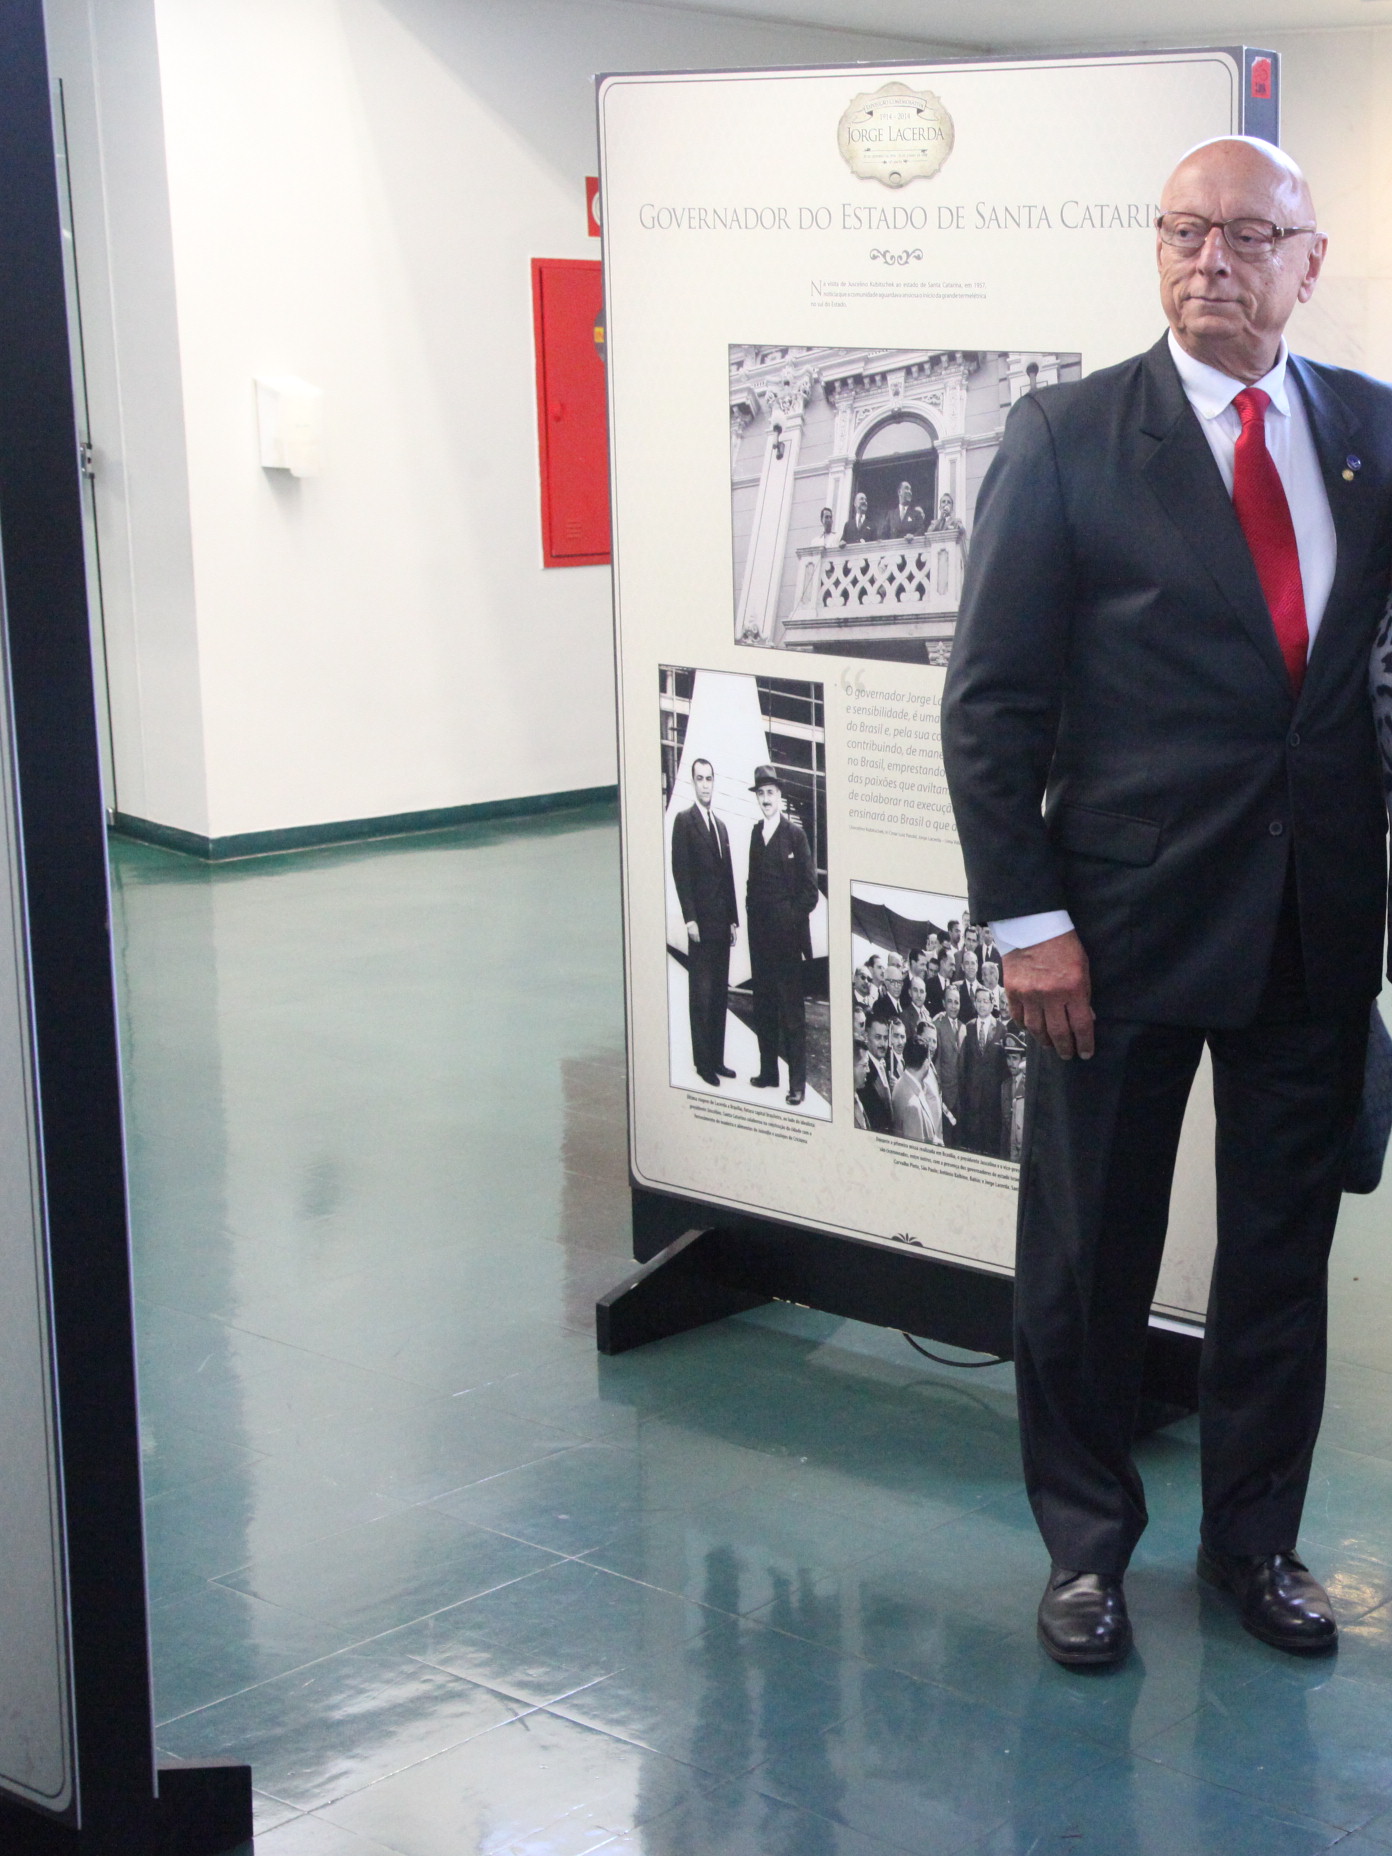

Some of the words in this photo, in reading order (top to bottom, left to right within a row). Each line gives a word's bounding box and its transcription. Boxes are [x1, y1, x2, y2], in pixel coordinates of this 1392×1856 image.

[848, 127, 883, 145] JORGE
[889, 126, 944, 141] LACERDA
[639, 204, 791, 230] GOVERNADOR
[798, 207, 832, 230] DO
[842, 203, 927, 230] ESTADO
[938, 206, 965, 230] DE
[976, 201, 1052, 230] SANTA
[855, 688, 905, 702] governador
[908, 692, 931, 707] Jorge
[846, 706, 851, 714] e
[853, 706, 910, 721] sensibilidade,
[912, 710, 917, 721] é
[919, 714, 939, 723] uma
[847, 721, 857, 731] do
[860, 722, 883, 735] Brasil
[894, 728, 911, 740] pela
[915, 730, 929, 740] sua
[847, 738, 904, 756] contribuindo,
[906, 744, 916, 756] de
[848, 758, 858, 766] no
[861, 757, 885, 772] Brasil,
[888, 762, 945, 777] emprestando
[848, 773, 863, 784] das
[865, 776, 896, 789] paixões
[900, 781, 914, 794] que
[849, 790, 859, 801] de
[861, 791, 902, 806] colaborar
[903, 799, 915, 808] na
[917, 798, 953, 815] execuçã
[849, 809, 885, 821] ensinará
[887, 814, 898, 824] ao
[900, 814, 923, 827] Brasil
[925, 819, 931, 828] o
[933, 821, 949, 834] que
